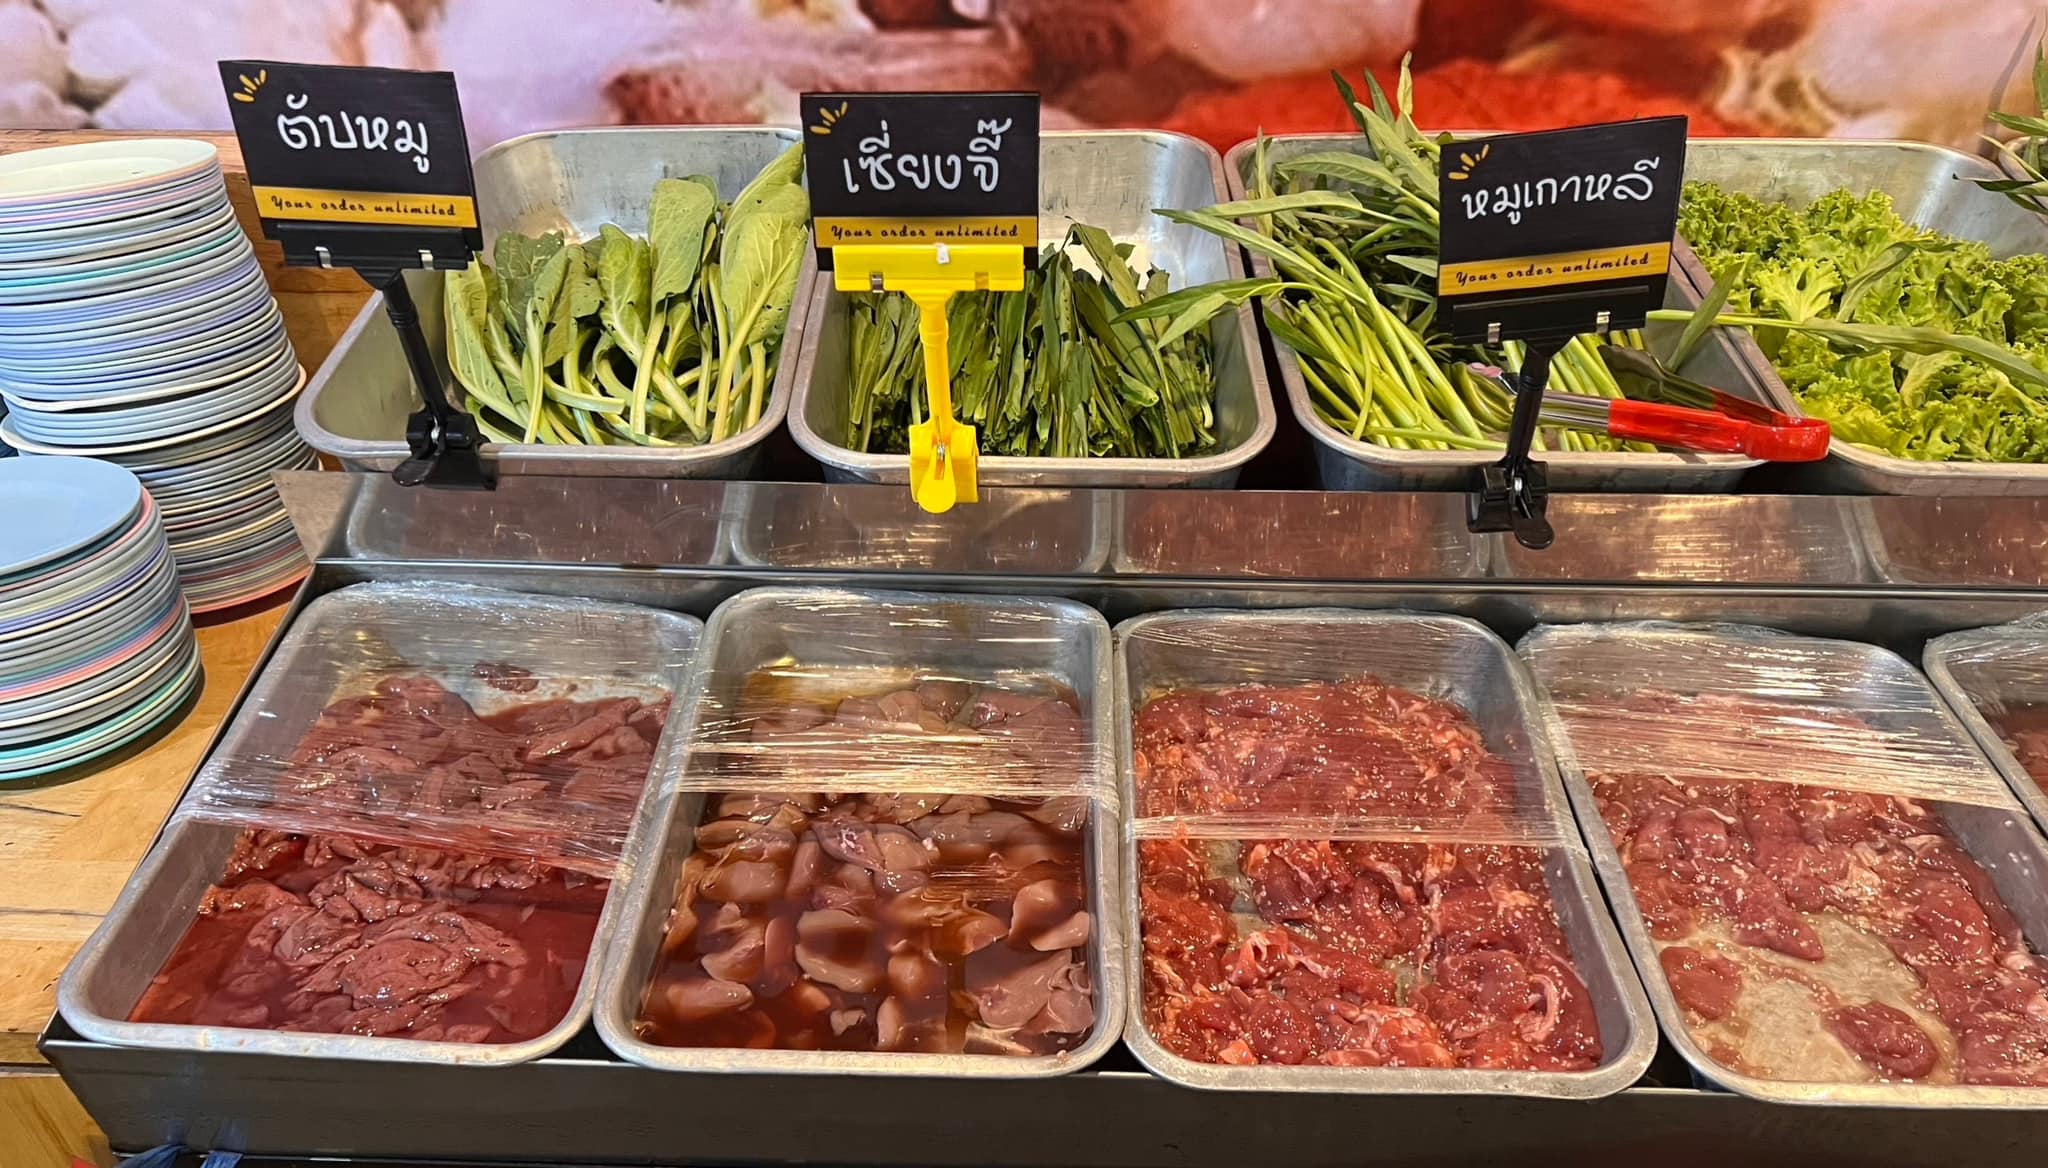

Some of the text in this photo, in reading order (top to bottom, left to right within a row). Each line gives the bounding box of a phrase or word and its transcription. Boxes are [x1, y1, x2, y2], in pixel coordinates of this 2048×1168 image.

[277, 93, 430, 174] ตับหมู
[842, 117, 1013, 194] เซี่ยงจี๊
[271, 195, 457, 217] Your order unlimited
[1461, 156, 1660, 225] หมูเกาหลี
[831, 223, 1019, 242] Your order unlimited
[1455, 252, 1650, 287] Your order unlimited
